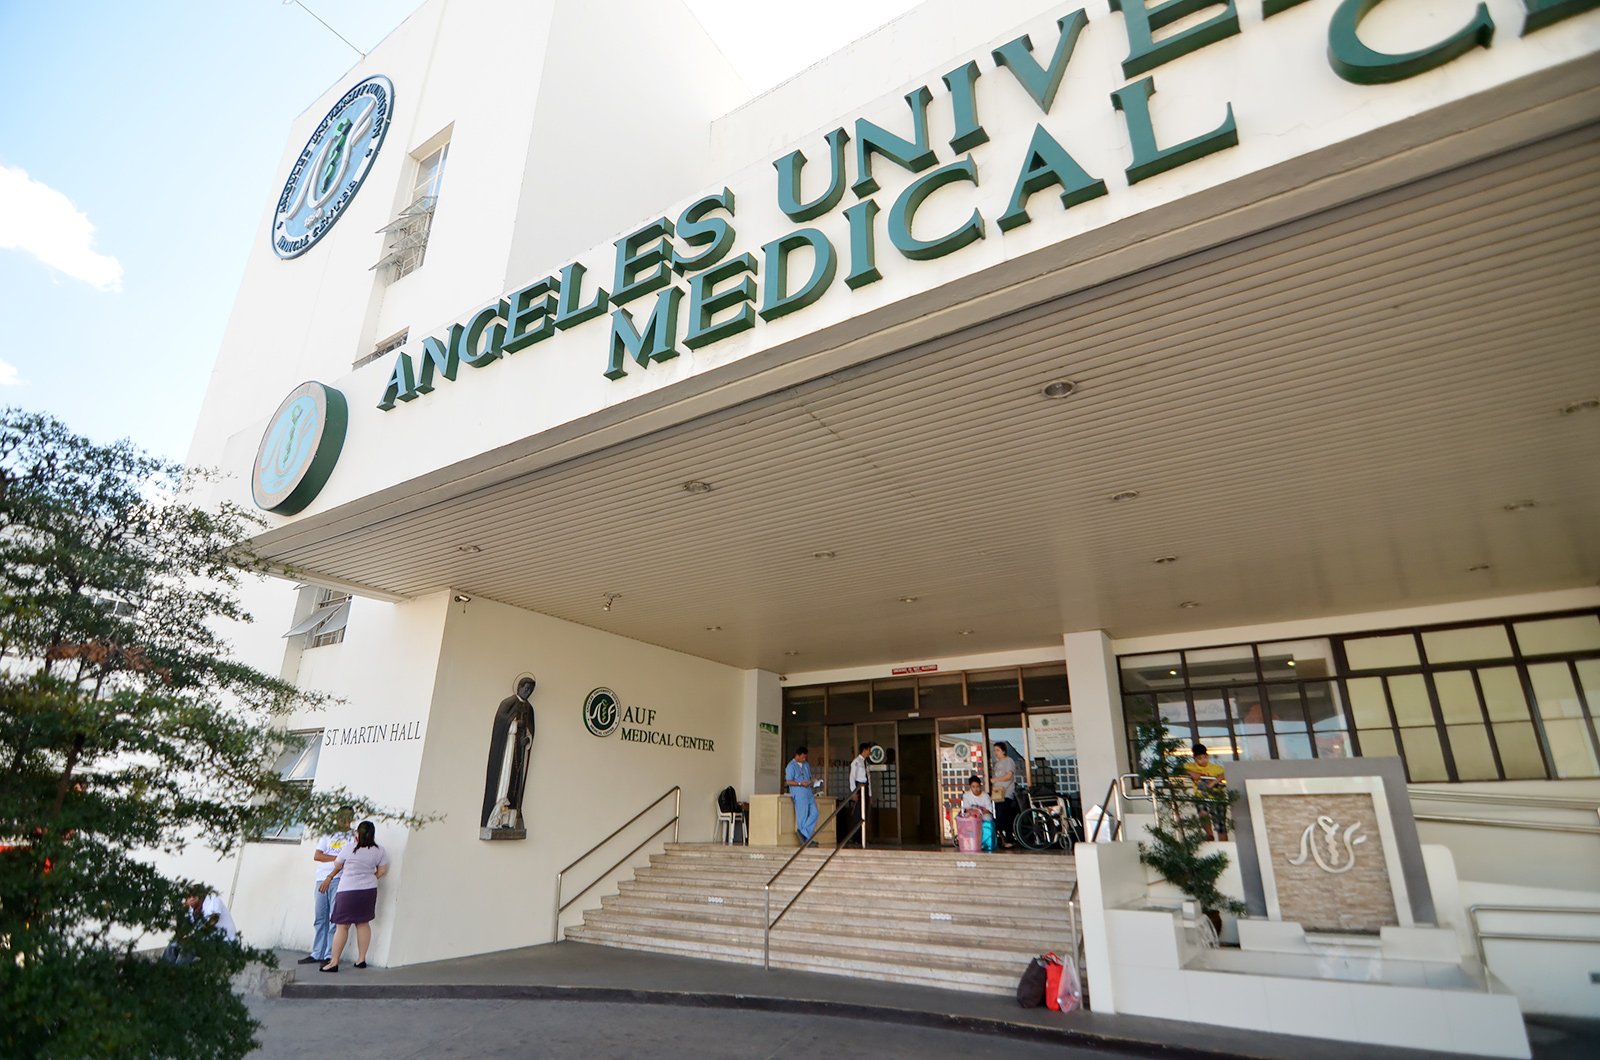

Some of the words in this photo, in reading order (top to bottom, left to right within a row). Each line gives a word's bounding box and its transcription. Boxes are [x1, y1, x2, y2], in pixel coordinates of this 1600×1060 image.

[376, 186, 735, 411] ANGELES
[772, 0, 1320, 222] UNIVE
[603, 76, 1239, 380] MEDICAL
[622, 706, 657, 726] AUF
[341, 724, 387, 745] MARTIN
[389, 721, 421, 741] HALL
[620, 727, 674, 746] MEDICAL
[675, 735, 715, 752] CENTER
